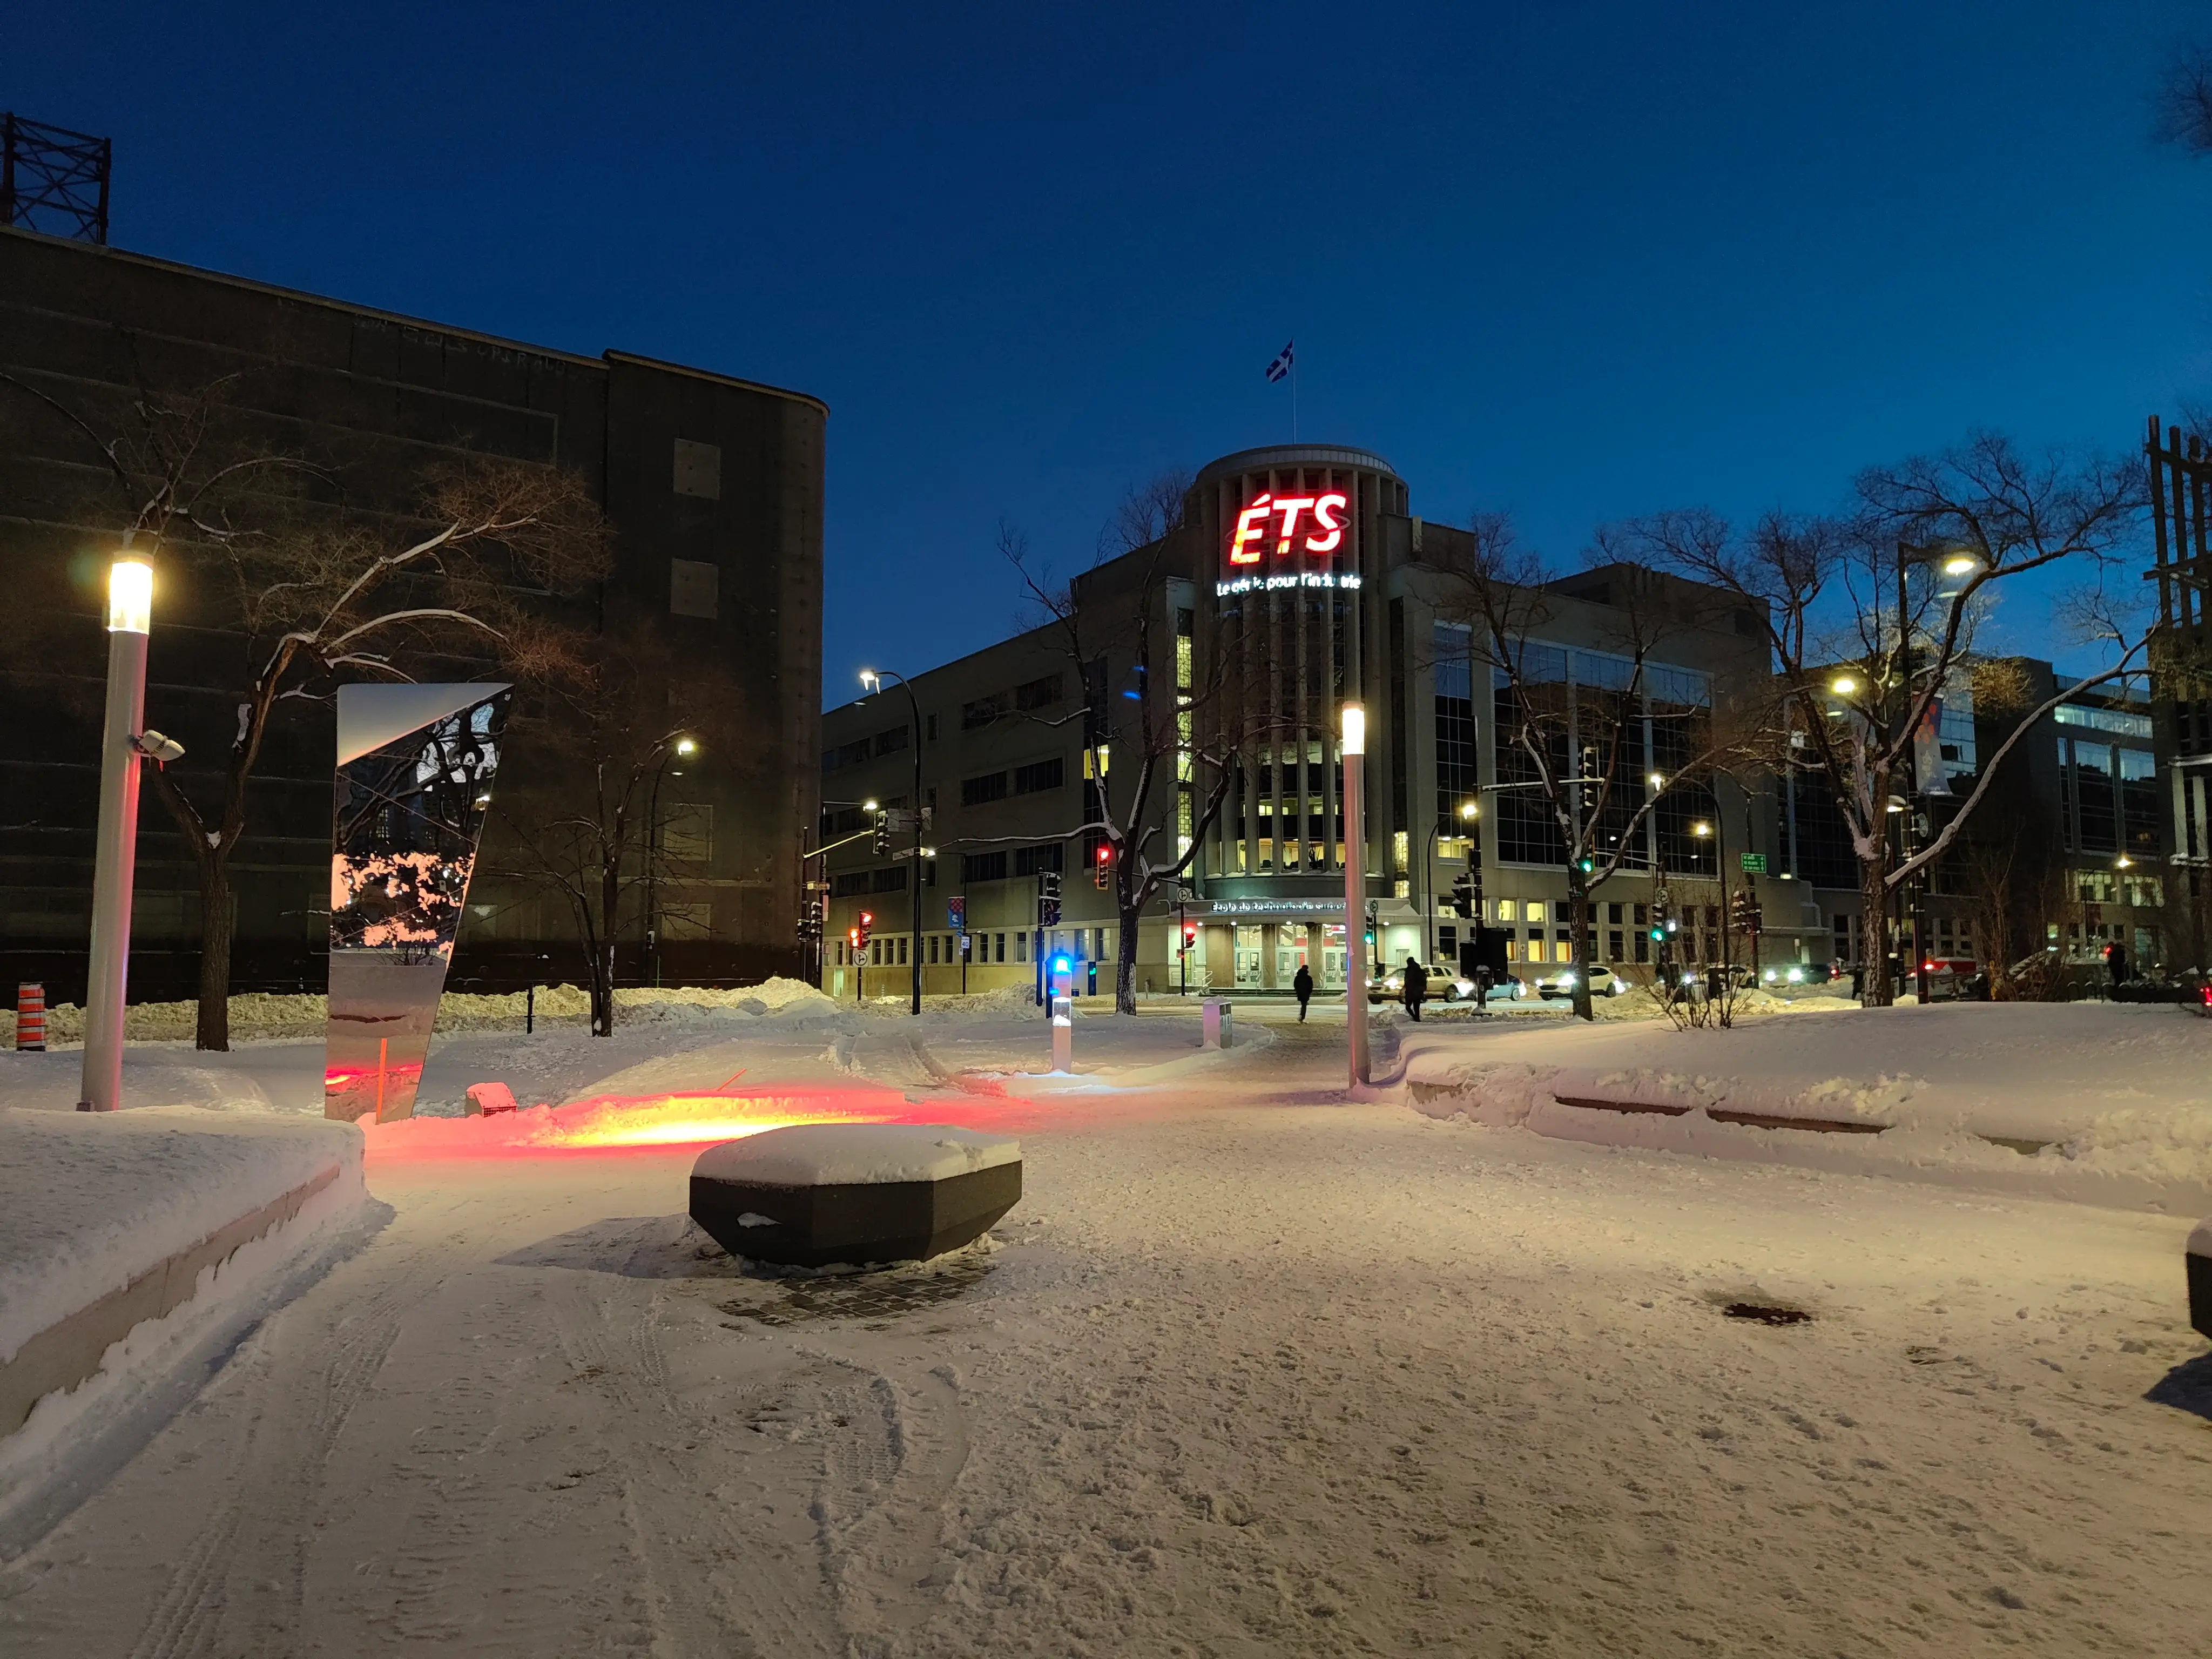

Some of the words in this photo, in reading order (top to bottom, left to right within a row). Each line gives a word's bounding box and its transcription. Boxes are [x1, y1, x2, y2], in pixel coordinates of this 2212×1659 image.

[1230, 493, 1346, 565] ÉTS
[1216, 583, 1230, 597] Le
[1266, 576, 1298, 591] pour
[1212, 901, 1237, 912] École
[1238, 902, 1251, 912] de
